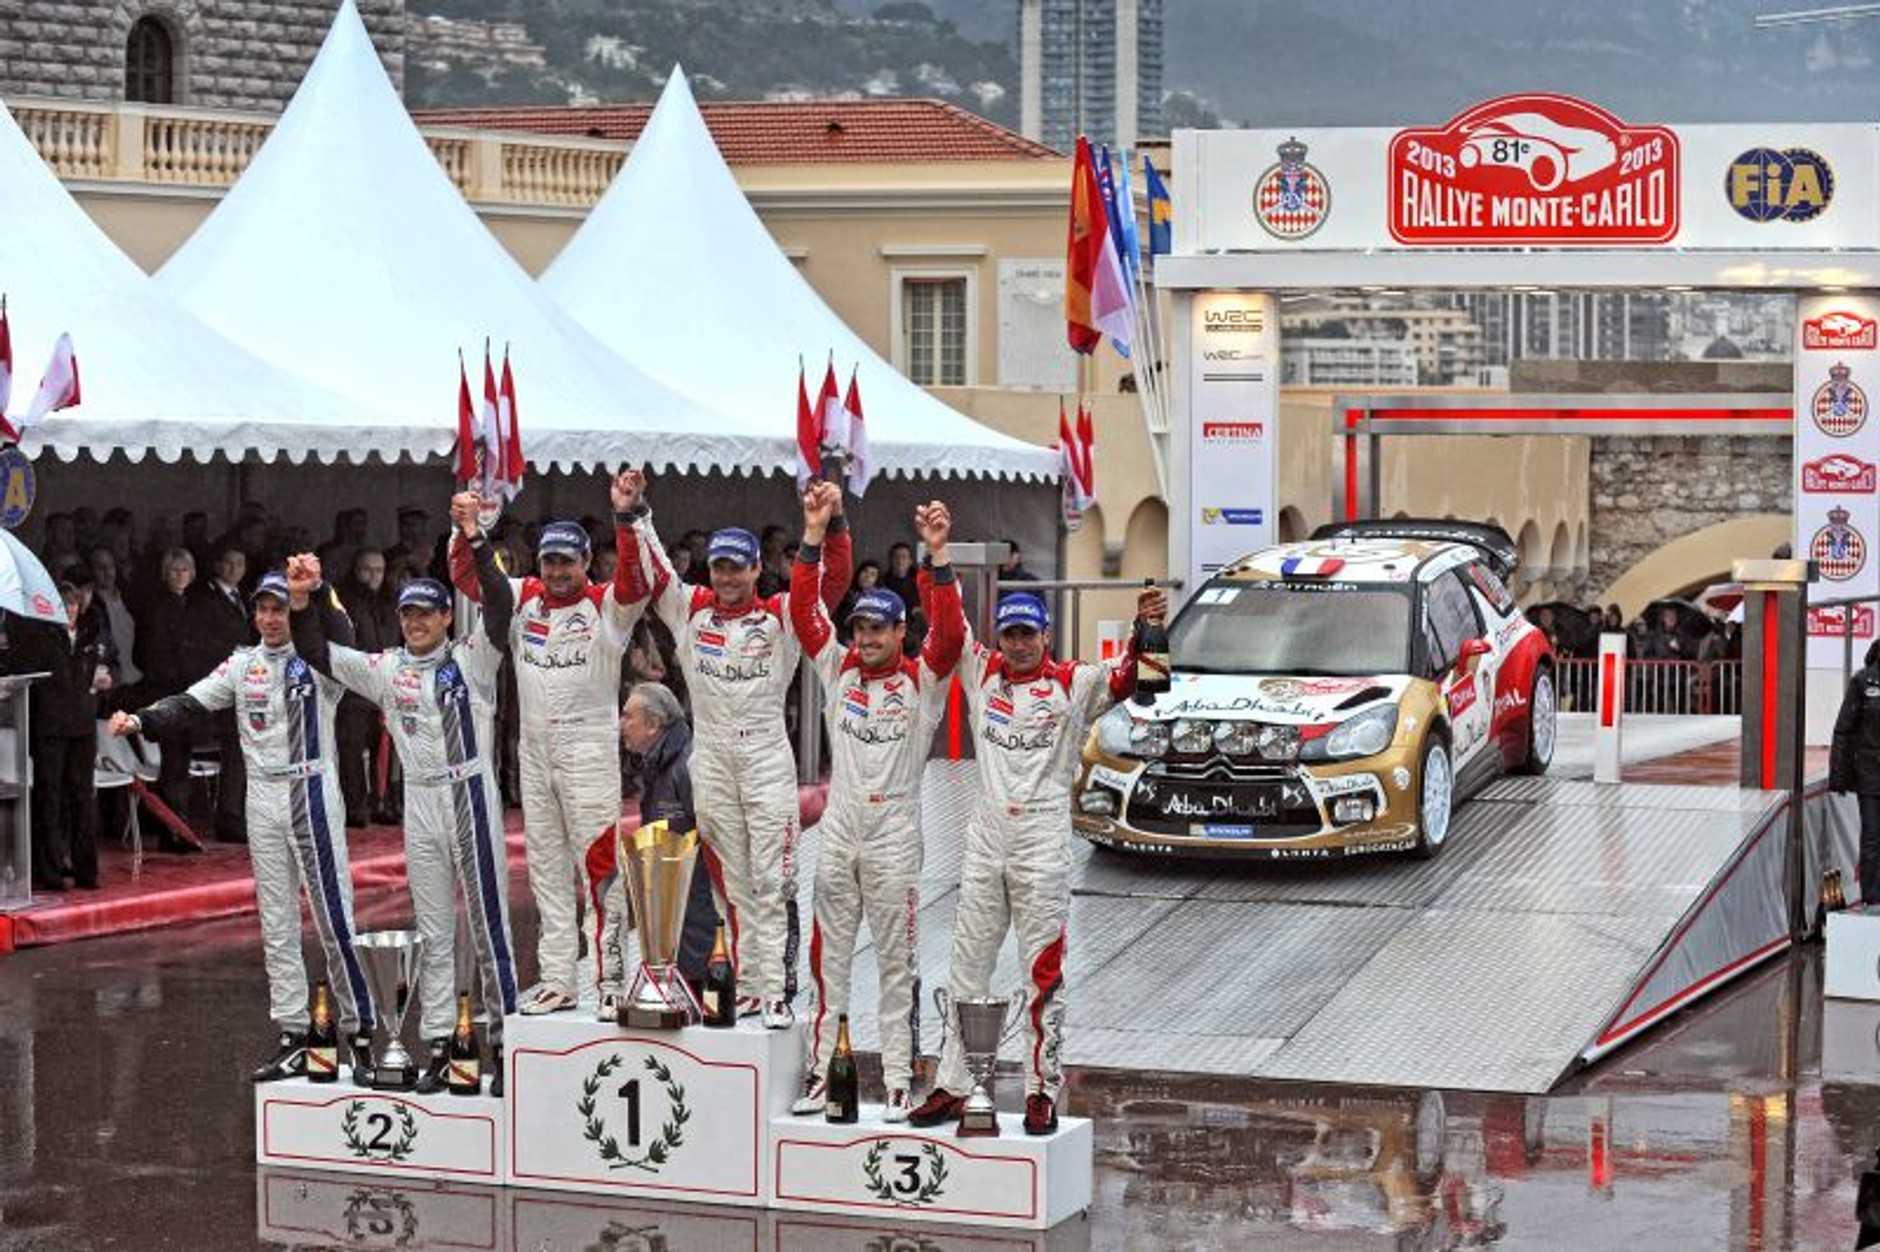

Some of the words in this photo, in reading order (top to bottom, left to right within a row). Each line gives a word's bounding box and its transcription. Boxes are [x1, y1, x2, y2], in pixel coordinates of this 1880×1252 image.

[1406, 140, 1456, 179] 2013
[1619, 137, 1663, 176] 2013
[1402, 168, 1484, 228] RALLYE
[1491, 168, 1666, 228] MONTE-CARLO
[1163, 793, 1206, 816] Abu
[1212, 795, 1278, 817] Dhabi
[366, 1113, 392, 1150] 2
[618, 1078, 641, 1147] 1
[893, 1155, 922, 1193] 3
